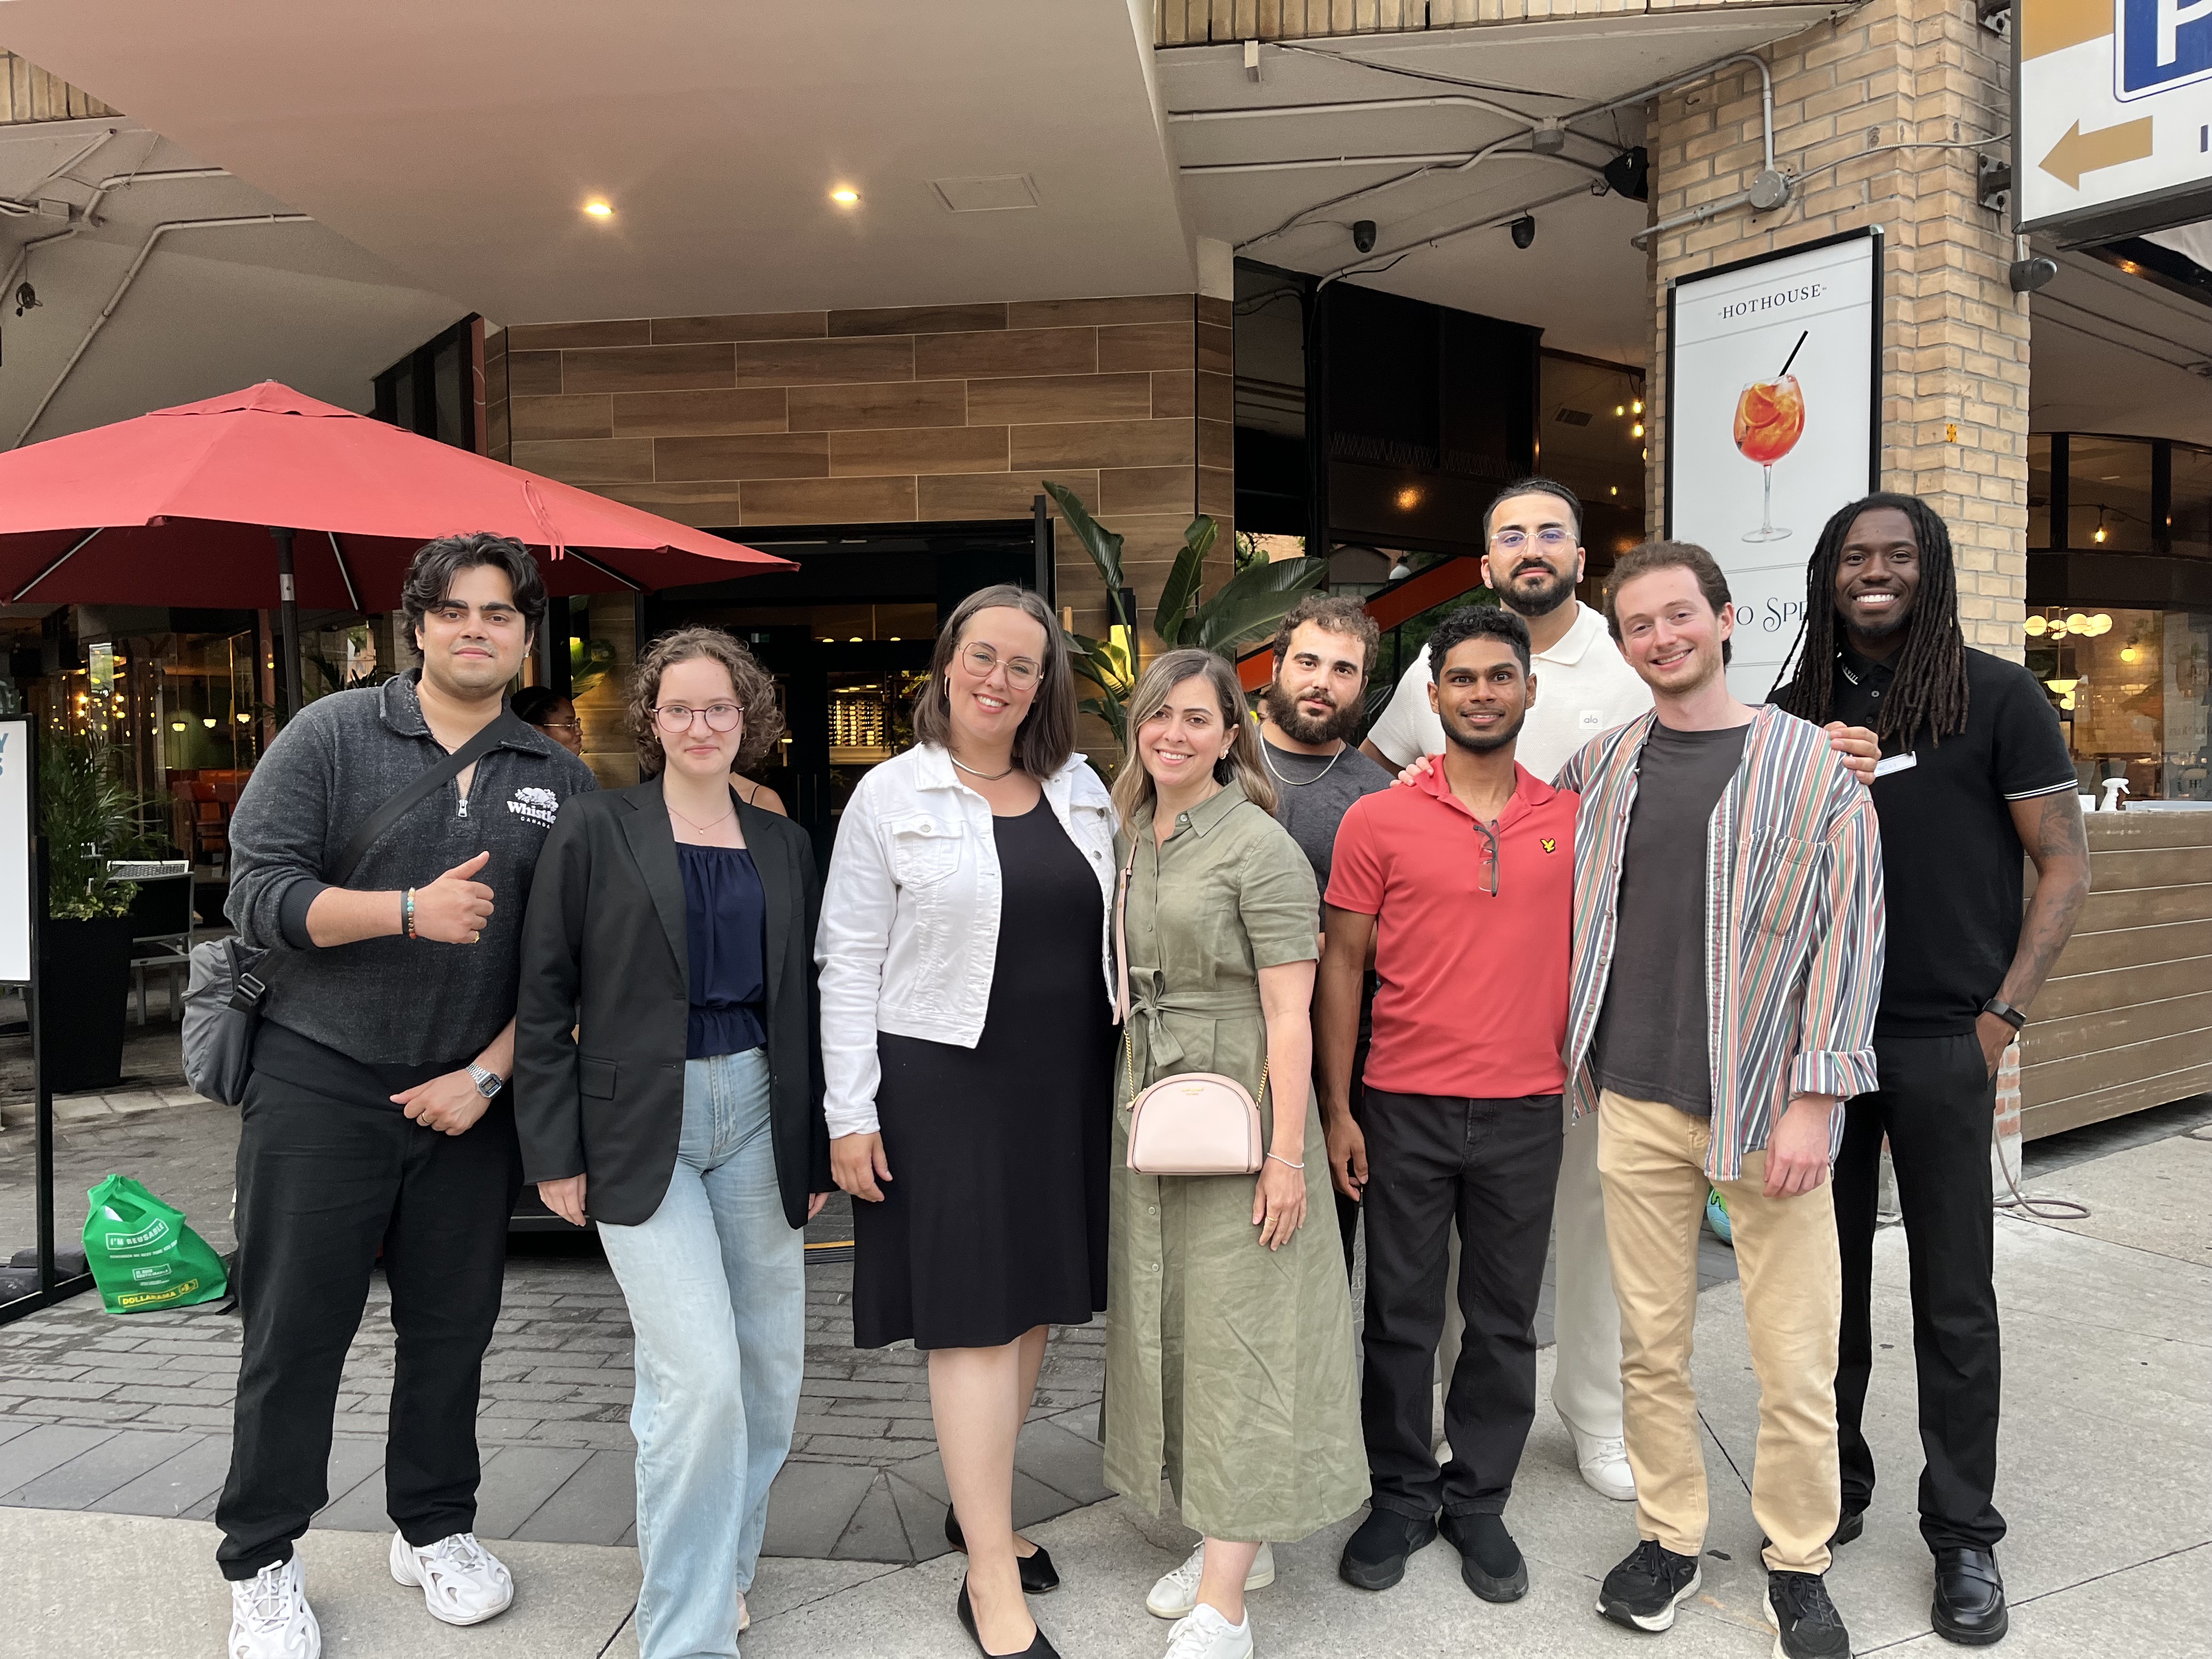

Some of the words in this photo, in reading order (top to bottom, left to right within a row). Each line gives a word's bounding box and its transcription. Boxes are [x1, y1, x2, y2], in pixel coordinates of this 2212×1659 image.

[1723, 284, 1821, 319] HOTHOUSE
[1584, 715, 1598, 723] alo
[506, 800, 556, 824] Whistle
[521, 816, 550, 829] CANADA
[126, 1222, 164, 1245] REUSABLE
